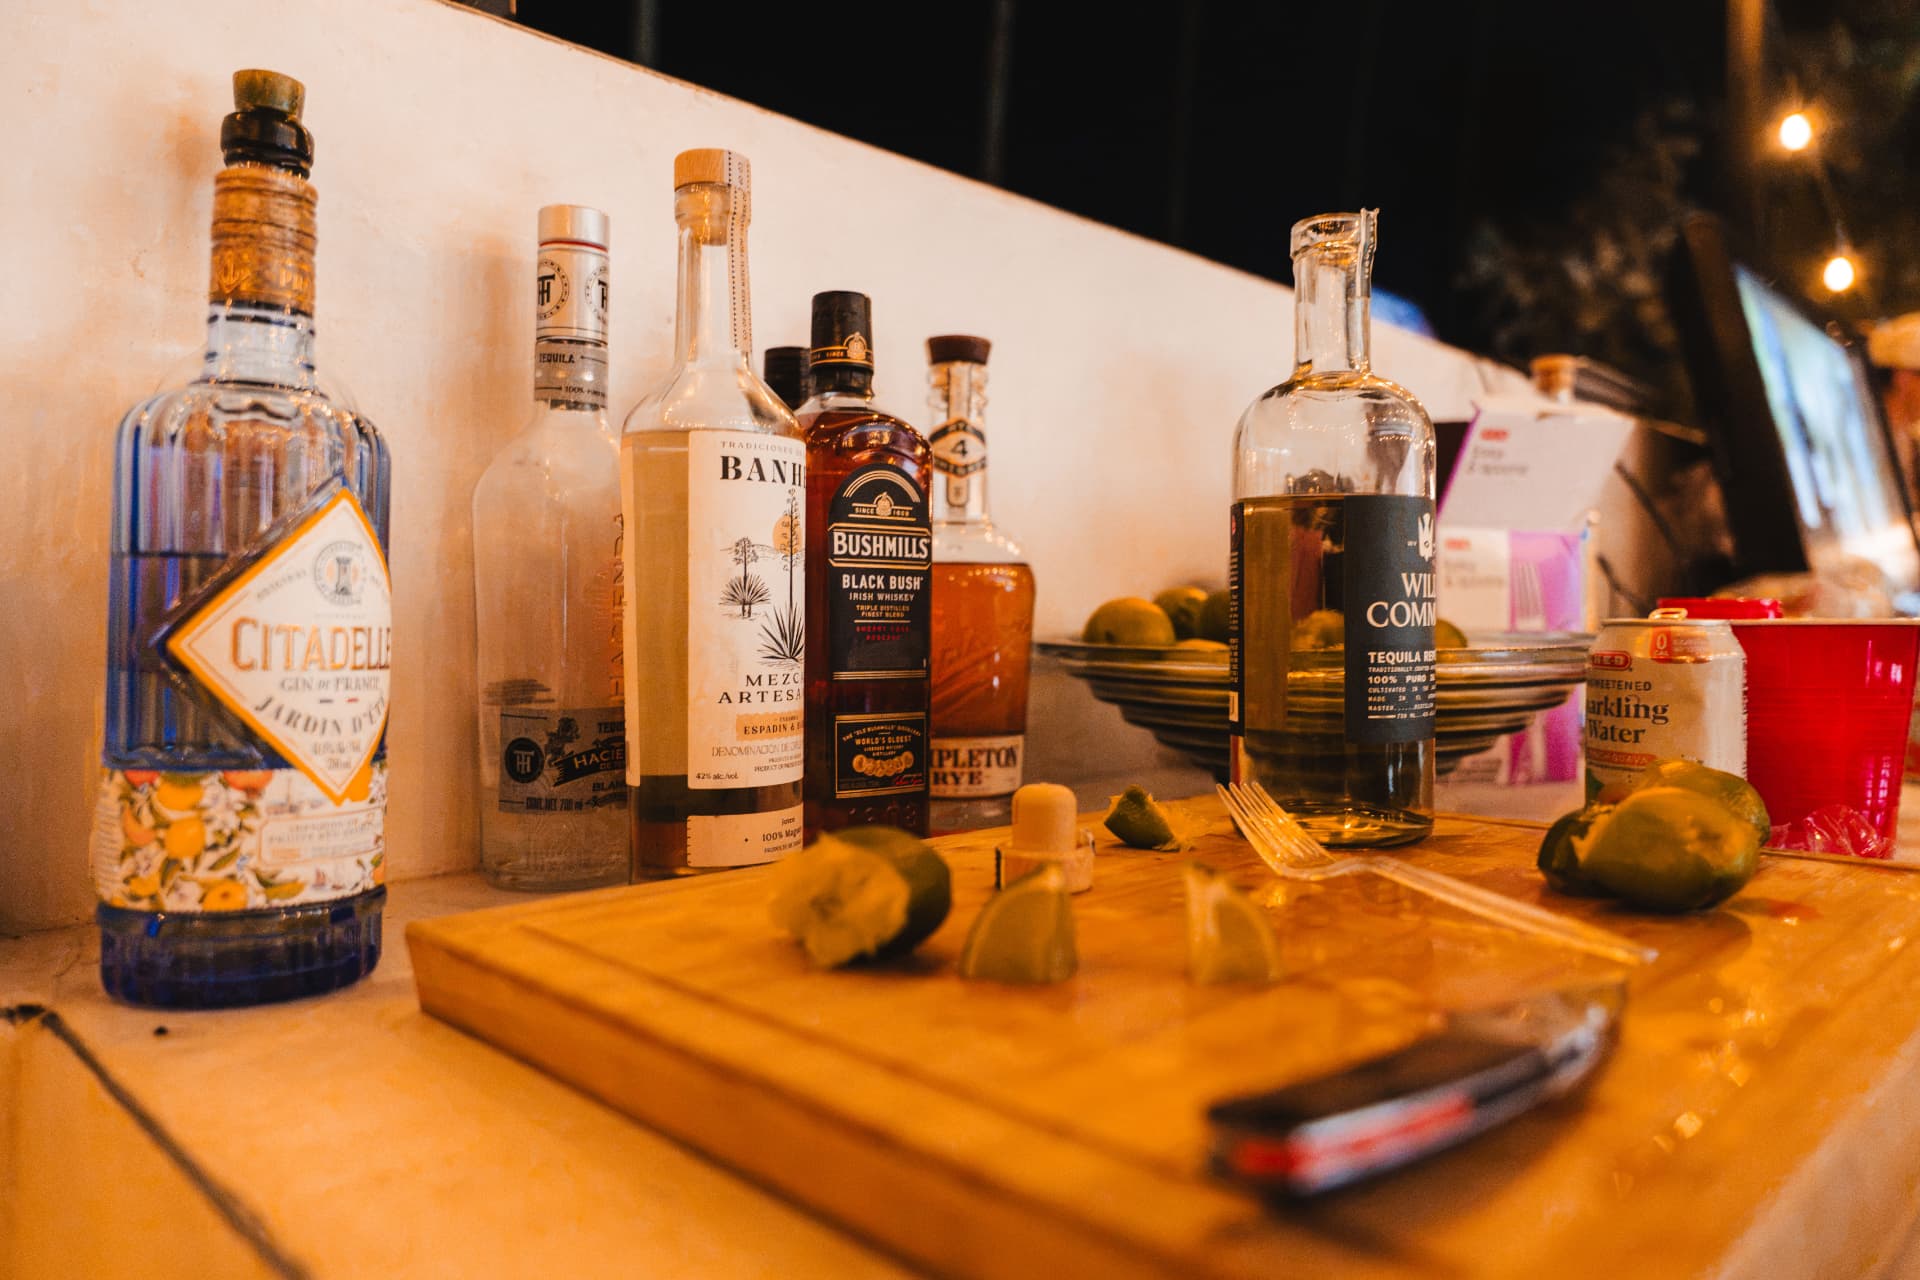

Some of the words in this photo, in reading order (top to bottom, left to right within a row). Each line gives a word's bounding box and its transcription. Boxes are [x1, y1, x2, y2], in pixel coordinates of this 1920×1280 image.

[539, 353, 575, 364] TEQUILA
[950, 440, 968, 456] 4
[833, 532, 929, 559] BUSHMILLS
[842, 574, 885, 590] BLACK
[889, 575, 921, 590] BUSH
[1401, 573, 1436, 598] WIL
[849, 592, 874, 600] IRISH
[877, 593, 914, 602] WHISKEY
[1656, 633, 1667, 650] 0
[1368, 651, 1421, 665] TEQUILA
[280, 677, 313, 692] GIN
[1368, 675, 1398, 684] 100%
[1368, 686, 1407, 694] CULTIVATED
[254, 696, 342, 736] JARDIN
[1588, 718, 1646, 744] Water
[695, 772, 711, 780] 42%
[933, 771, 982, 785] RYE
[762, 832, 783, 842] 100%
